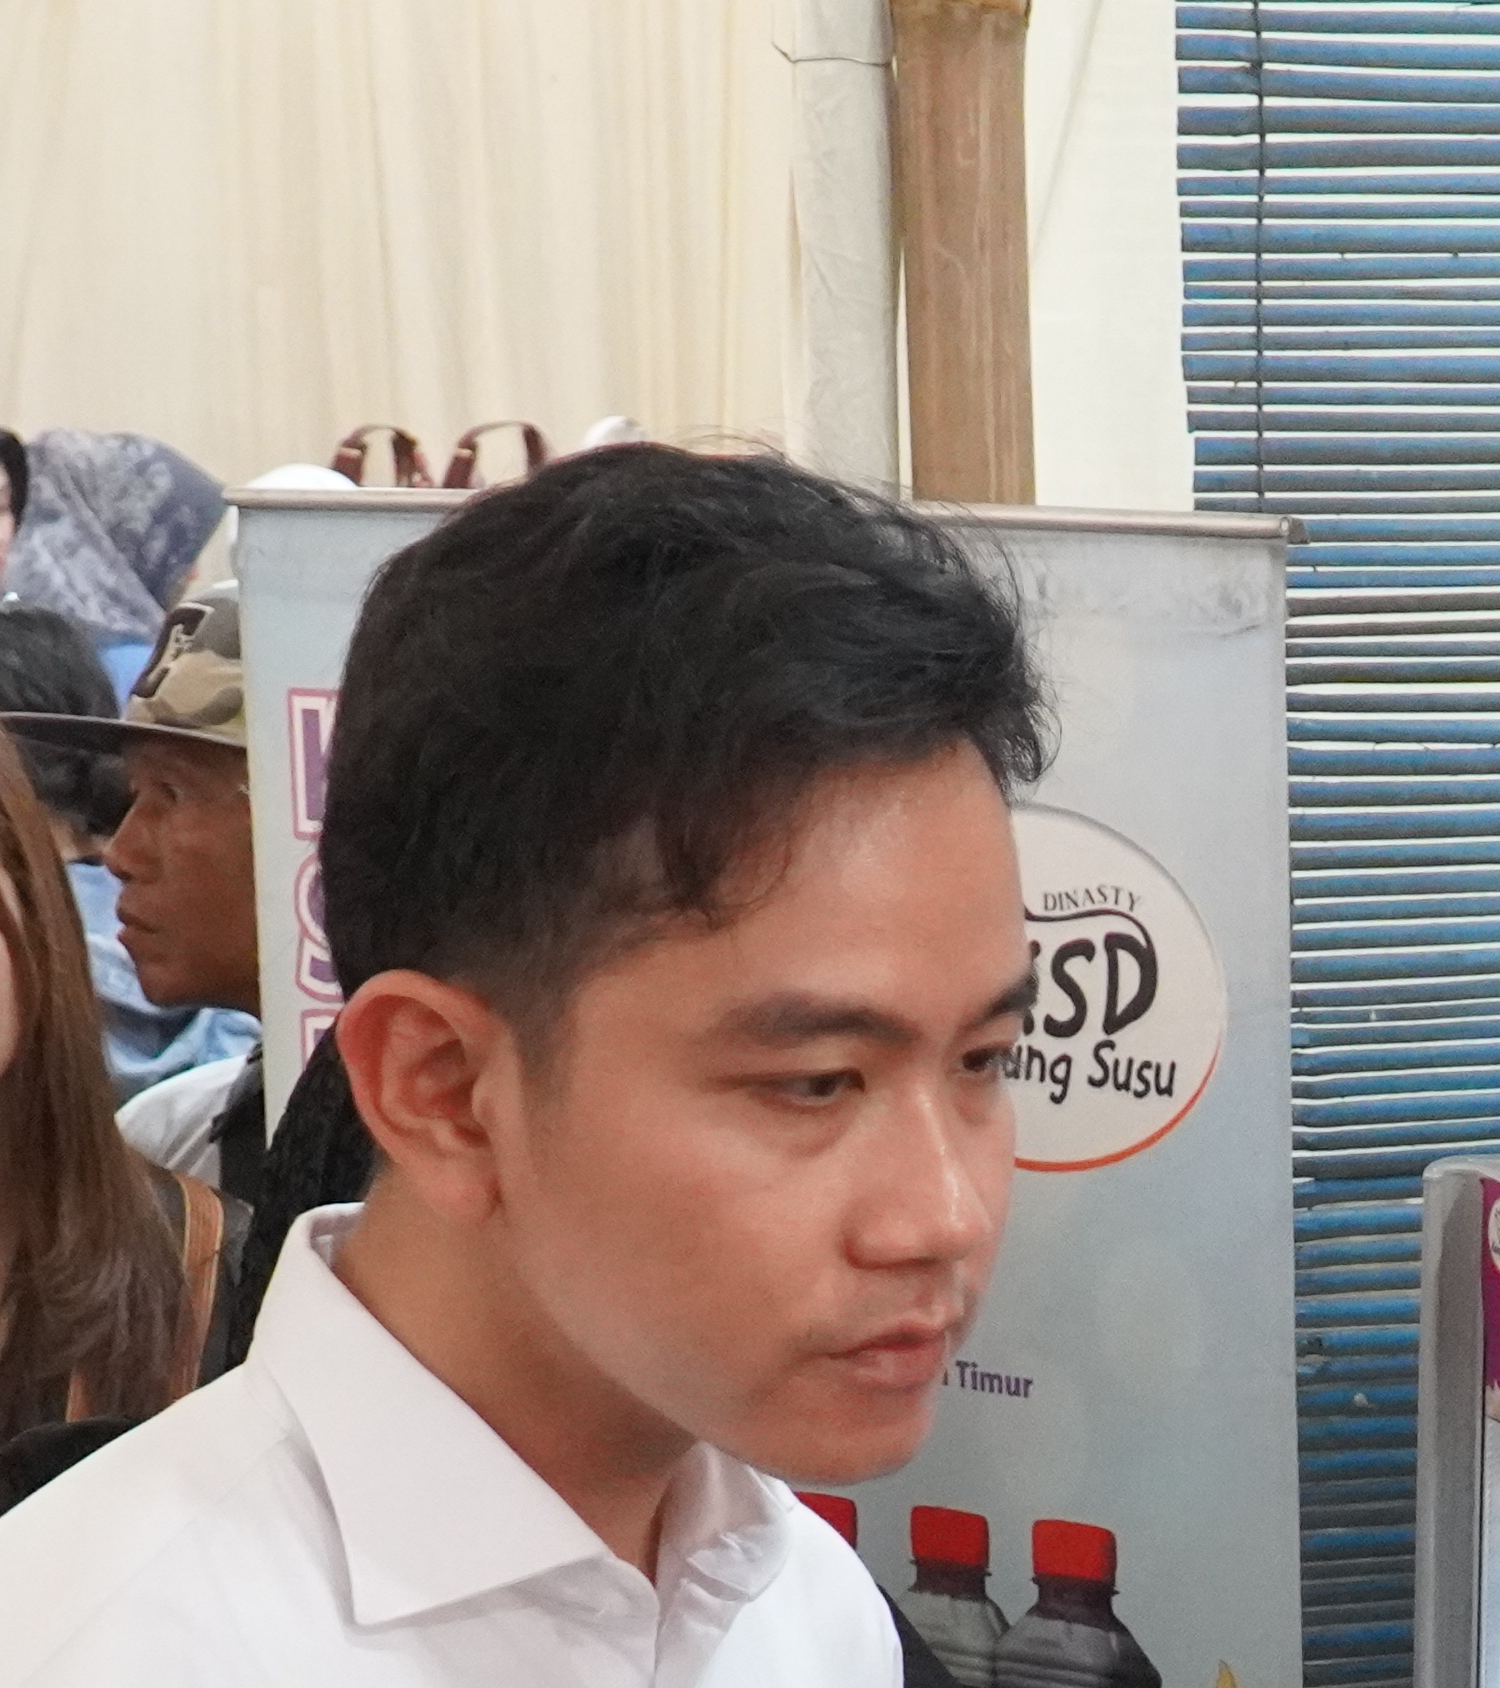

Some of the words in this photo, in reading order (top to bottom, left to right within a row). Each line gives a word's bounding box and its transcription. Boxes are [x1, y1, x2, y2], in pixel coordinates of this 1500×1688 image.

[1043, 885, 1141, 912] DINASTY
[1023, 932, 1158, 1038] SD
[1087, 1039, 1176, 1098] Susu
[955, 1360, 1033, 1398] Timur
